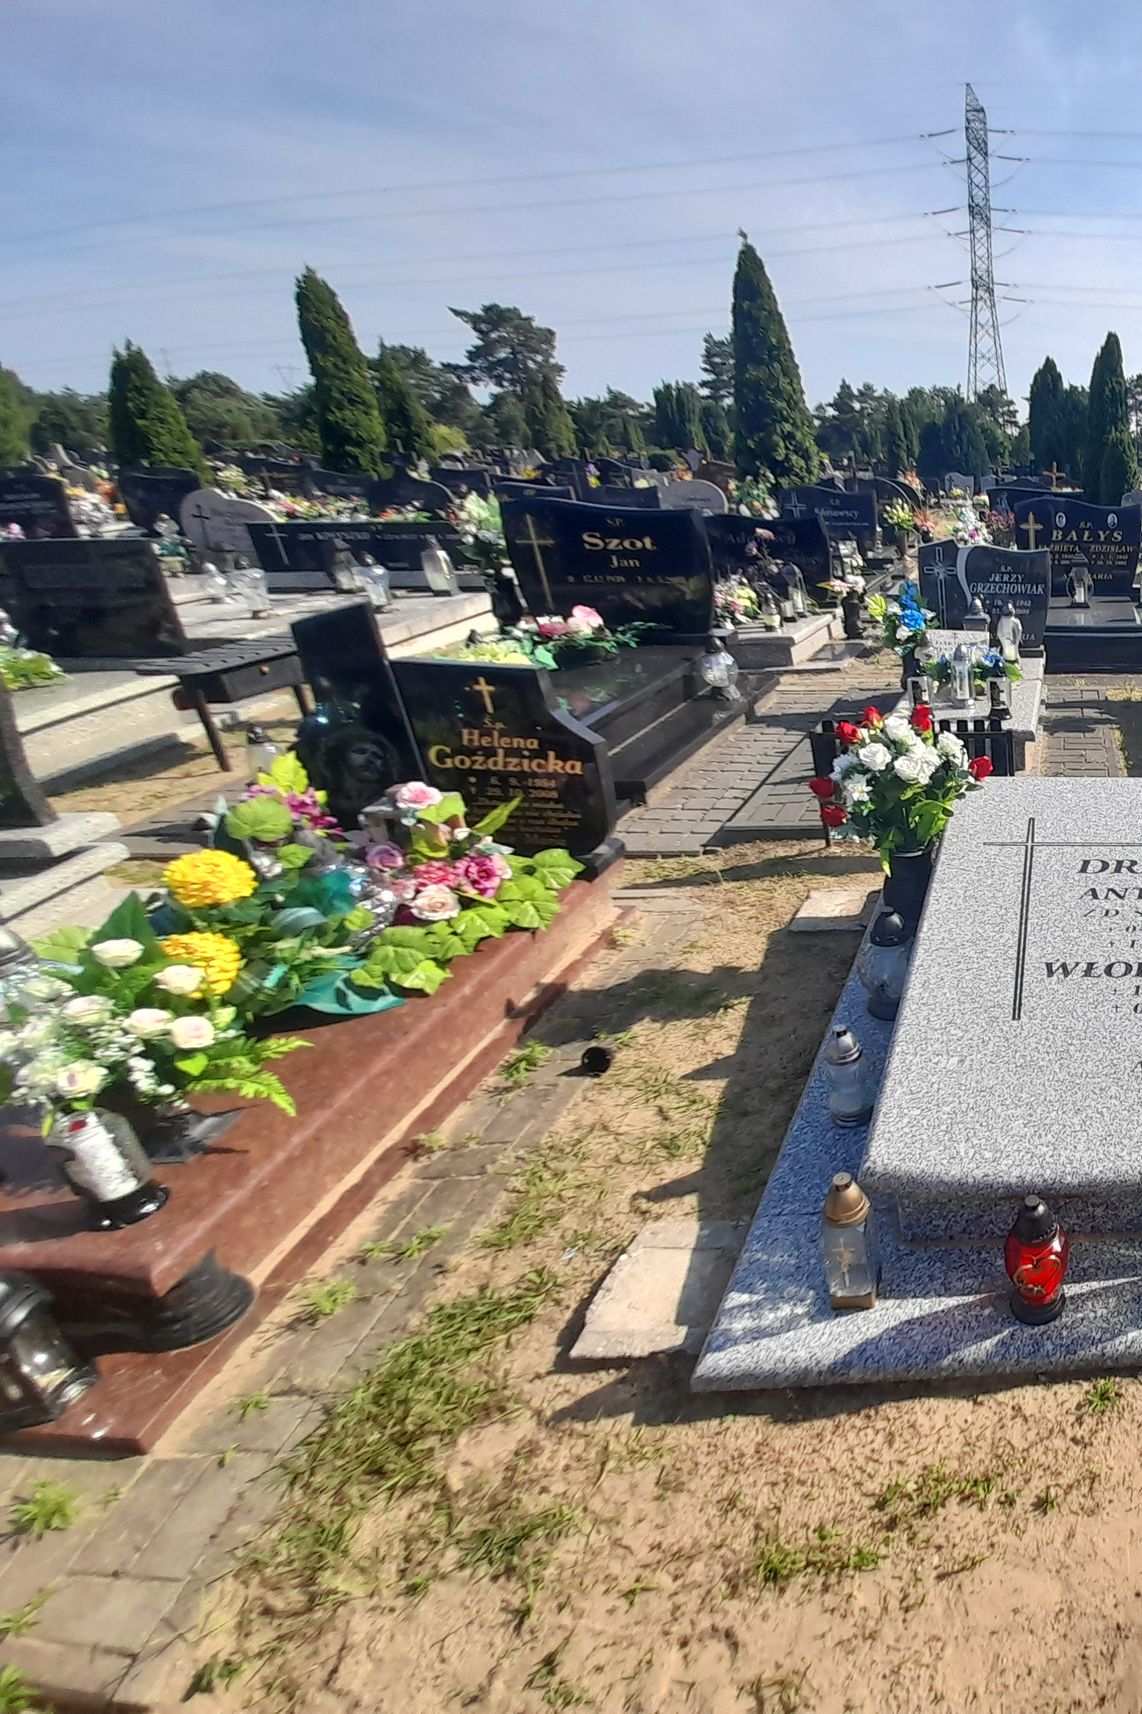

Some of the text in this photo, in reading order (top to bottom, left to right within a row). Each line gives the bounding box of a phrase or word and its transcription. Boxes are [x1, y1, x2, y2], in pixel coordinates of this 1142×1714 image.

[581, 531, 658, 551] Szot
[1051, 529, 1124, 543] BAŁYS
[1089, 544, 1136, 553] ZDZISŁAW
[609, 554, 641, 569] Jan
[988, 573, 1025, 583] JERZY
[969, 582, 1046, 596] GRZECHOWIAK
[461, 728, 539, 750] Helena
[427, 745, 584, 775] Goździcka
